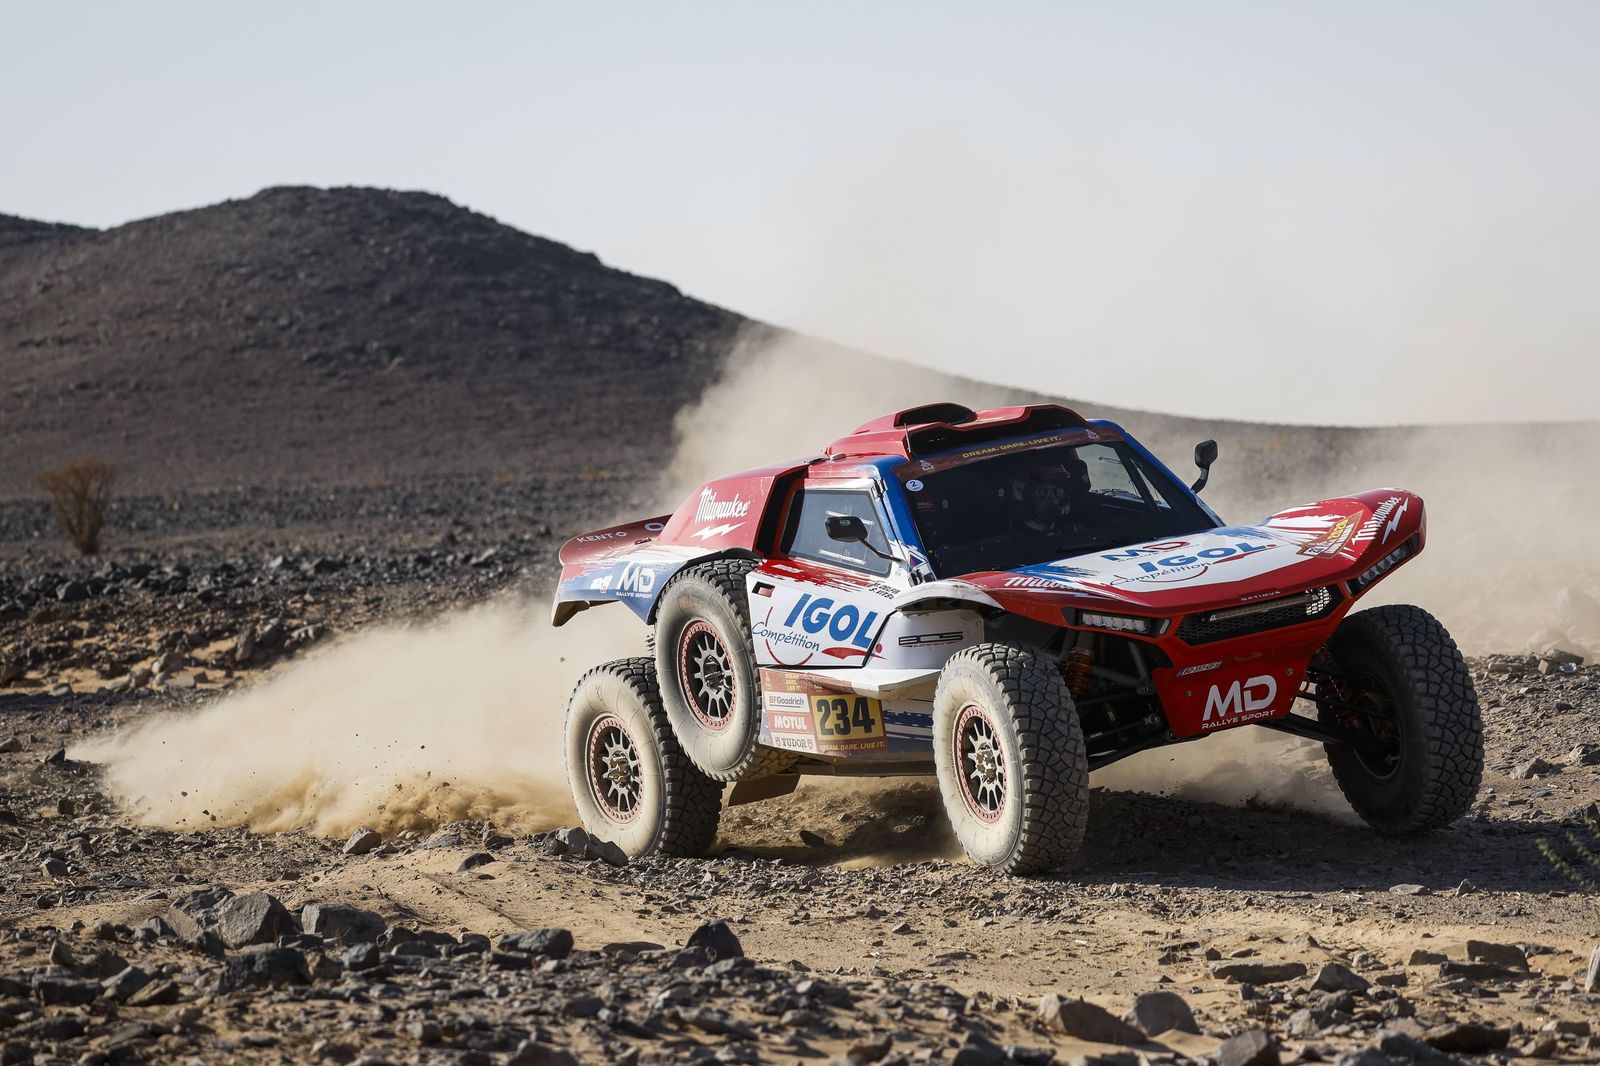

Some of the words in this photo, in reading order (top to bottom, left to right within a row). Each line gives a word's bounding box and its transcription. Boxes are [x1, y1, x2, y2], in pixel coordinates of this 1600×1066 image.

[962, 447, 999, 458] DREAM.
[1000, 442, 1028, 450] DARE.
[1029, 438, 1048, 446] LIVE
[695, 486, 750, 524] Milwaukee
[1351, 496, 1402, 546] Milwaukee
[576, 533, 614, 542] KENT
[1100, 541, 1190, 561] MD
[1138, 543, 1266, 573] IGOL
[616, 561, 655, 592] MD
[1110, 562, 1212, 585] Compétition
[784, 593, 878, 649] IGOL
[752, 622, 820, 651] Compétition
[769, 695, 804, 706] BFGoodrich
[1202, 674, 1277, 721] MD
[774, 715, 807, 730] MOTUL
[816, 696, 875, 736] 234
[1202, 717, 1239, 729] RALLYE
[1241, 709, 1276, 721] SPORT
[781, 738, 807, 748] TUDOR
